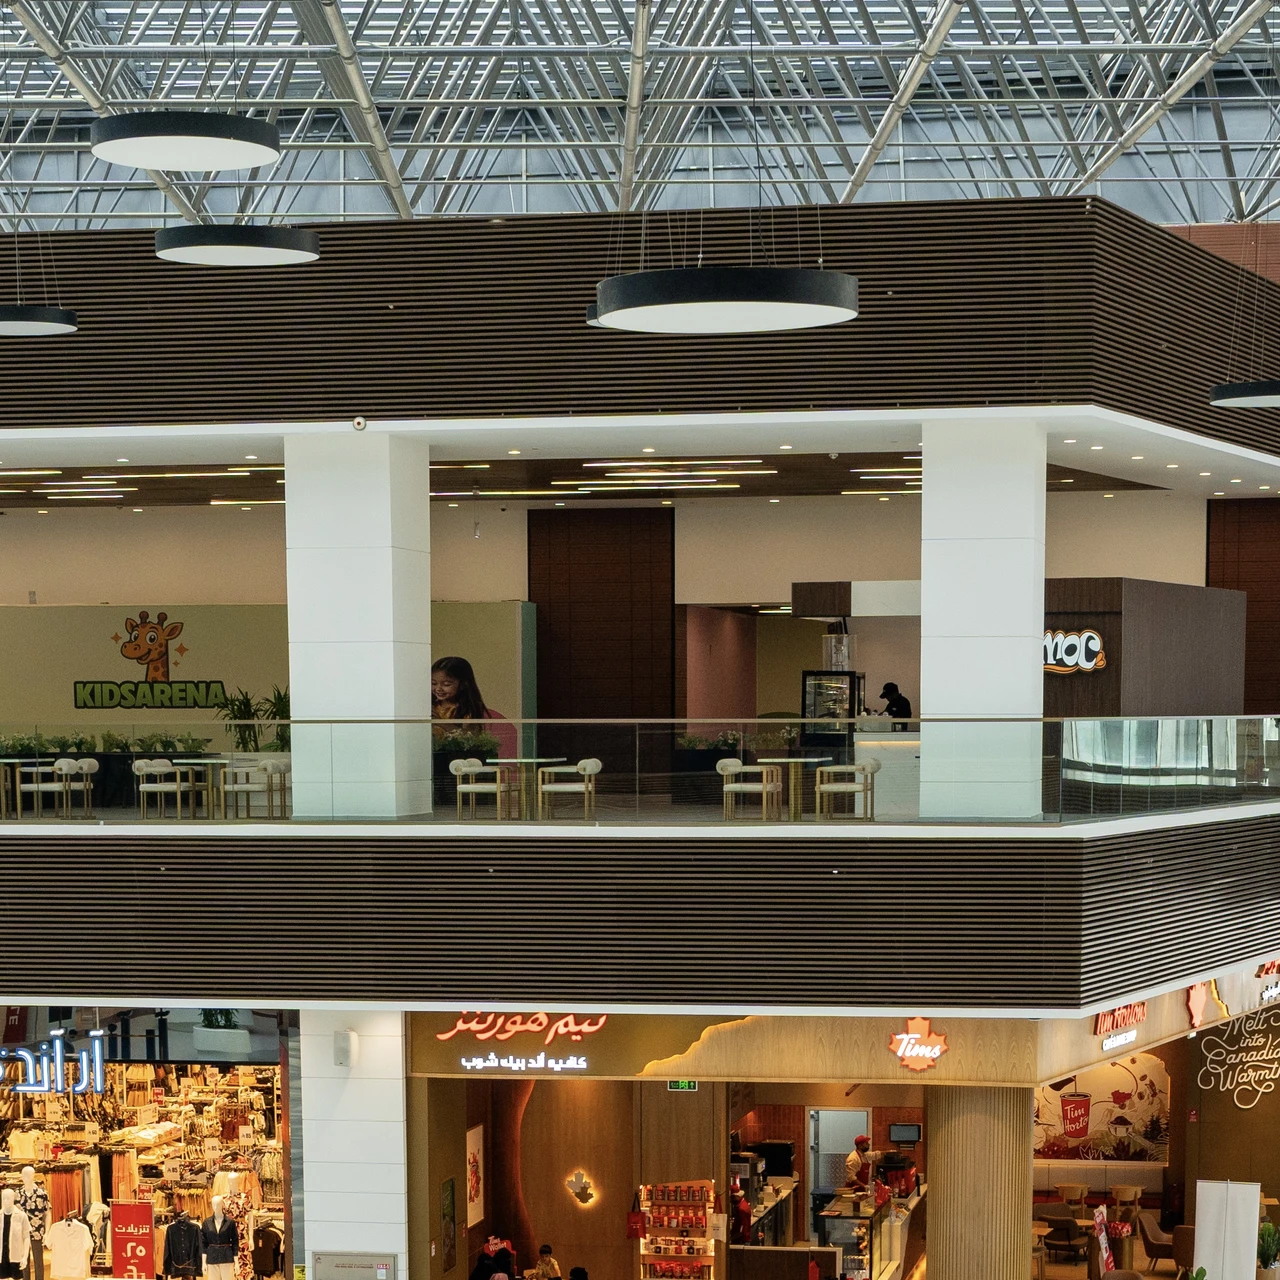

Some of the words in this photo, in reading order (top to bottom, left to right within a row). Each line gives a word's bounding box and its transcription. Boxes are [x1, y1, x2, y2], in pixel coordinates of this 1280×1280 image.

[74, 681, 228, 709] KIDSARENA
[895, 1033, 941, 1058] Tims
[1240, 1033, 1266, 1047] into
[1064, 1103, 1085, 1119] Tim
[115, 1223, 150, 1235] تنزيلات
